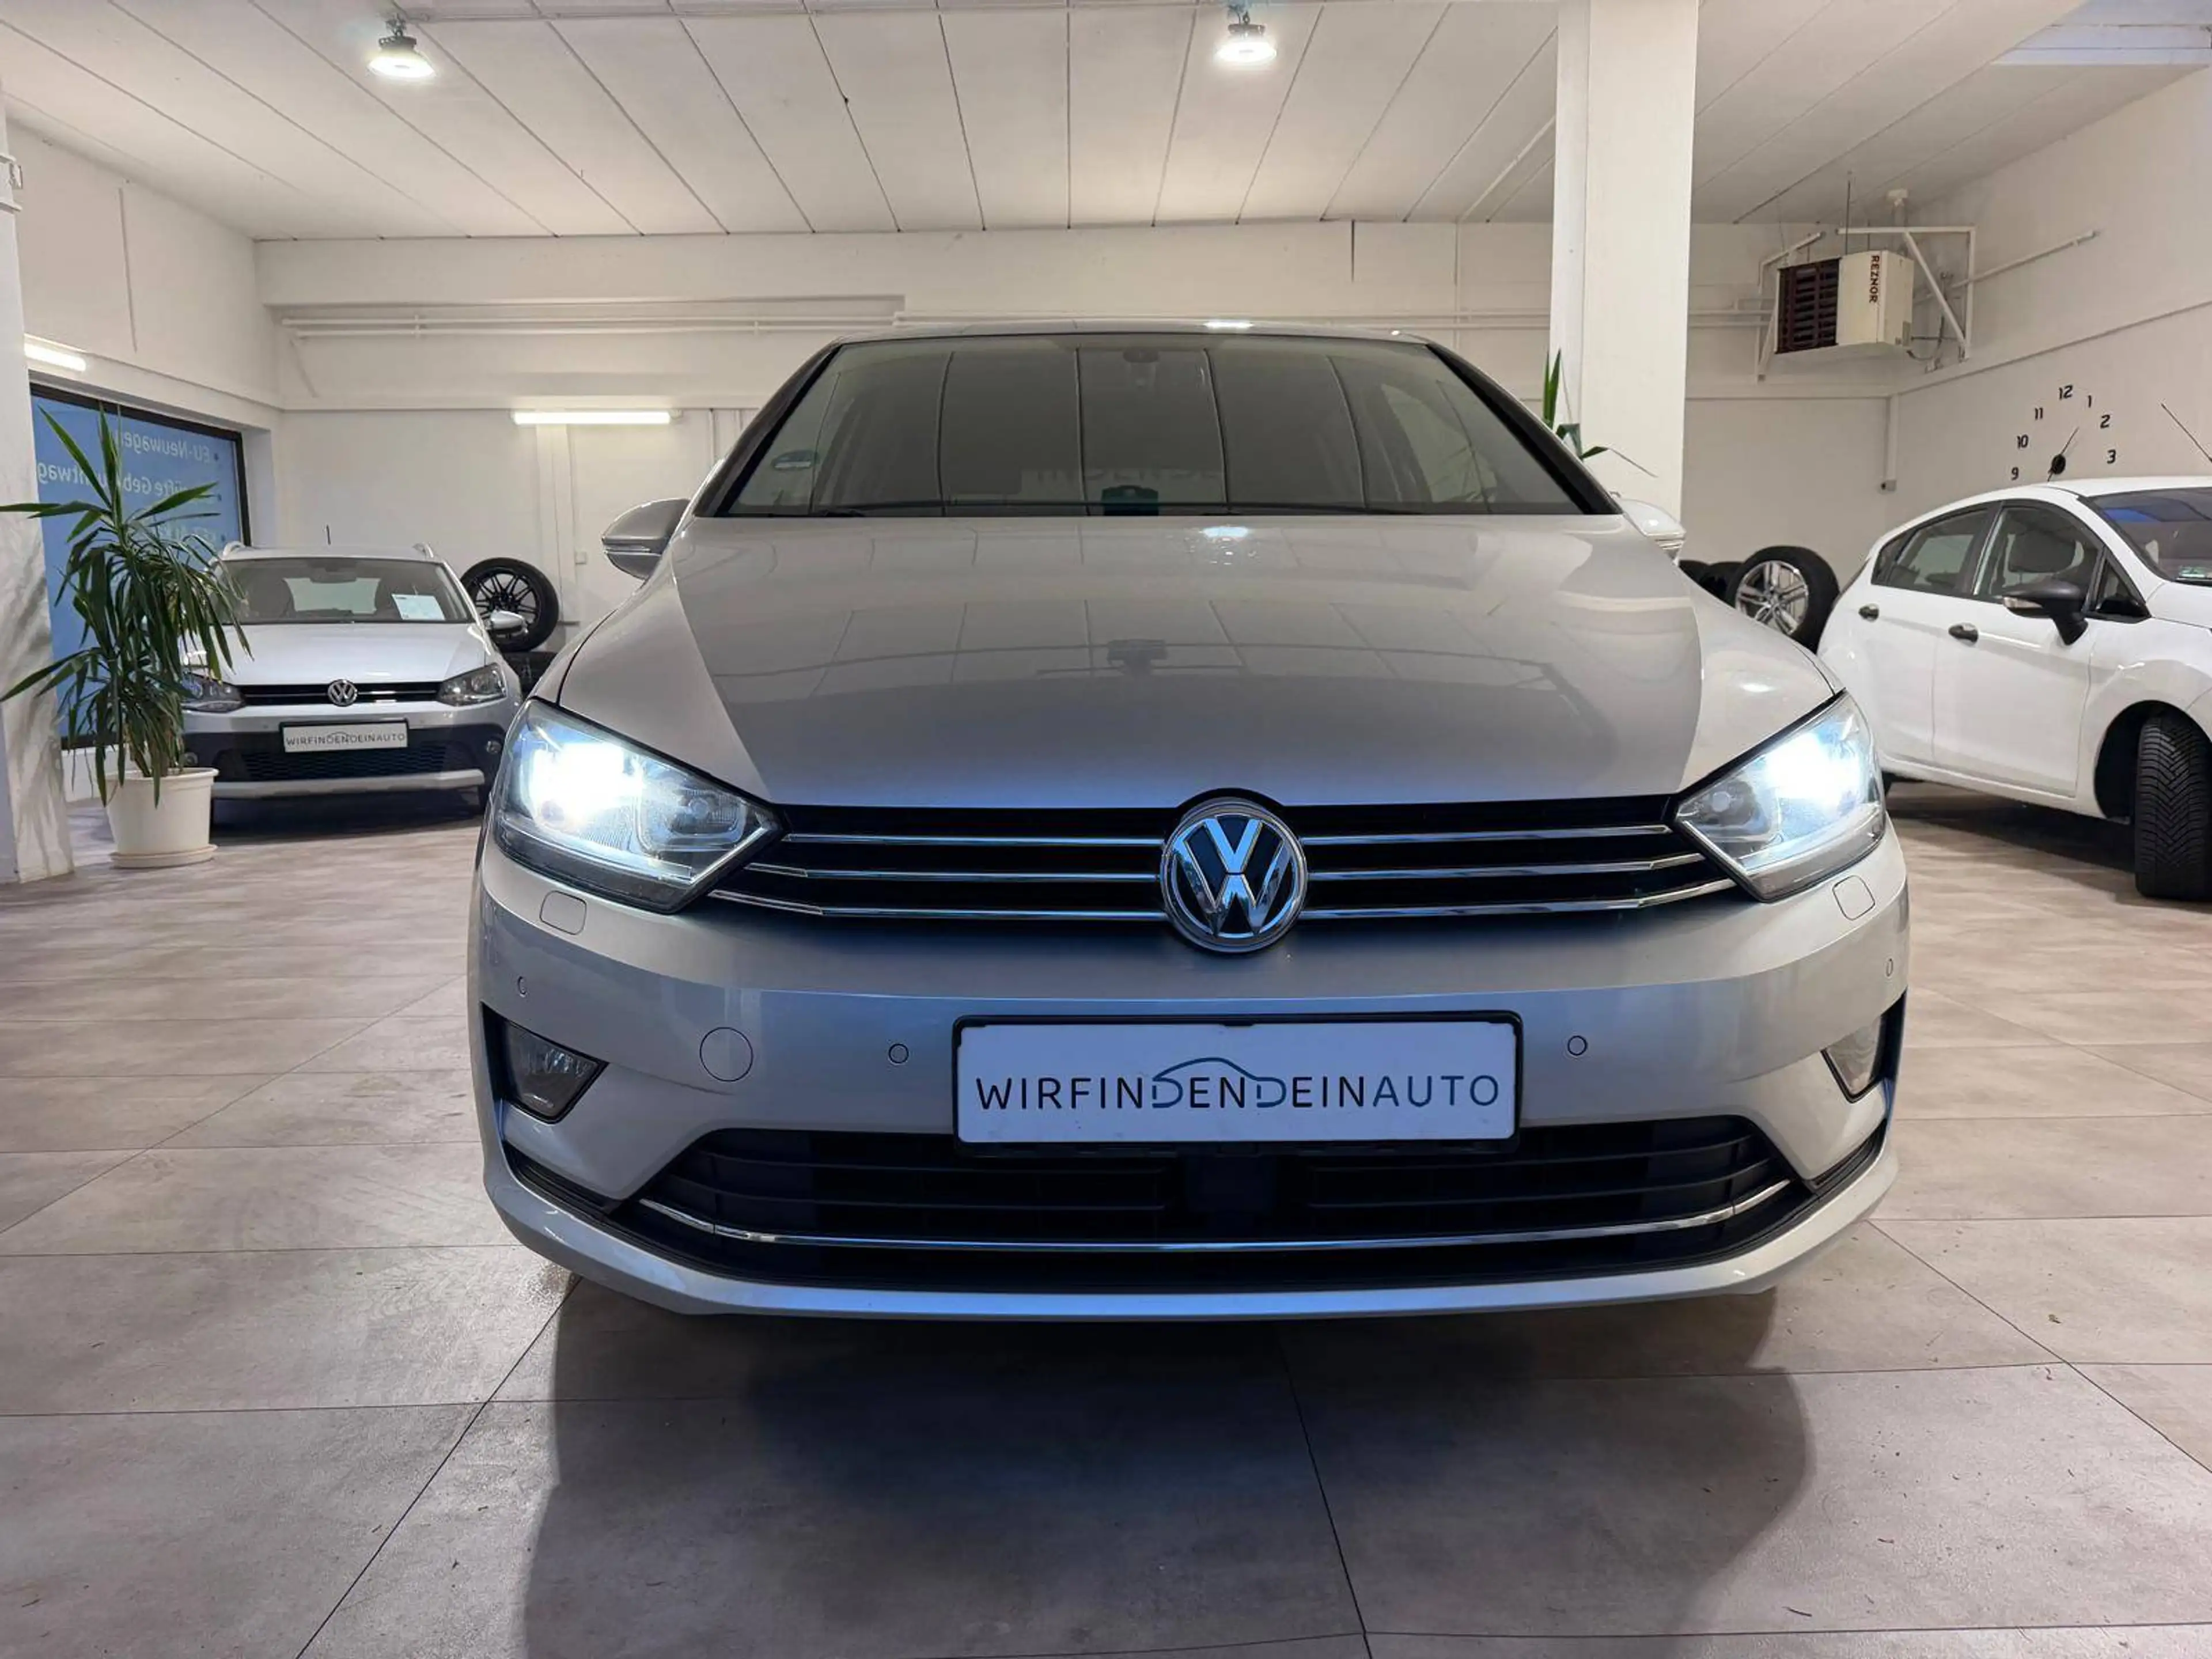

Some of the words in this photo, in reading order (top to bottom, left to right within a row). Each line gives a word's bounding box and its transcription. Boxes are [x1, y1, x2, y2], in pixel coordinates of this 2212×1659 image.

[1869, 255, 1880, 304] REZNOR
[2058, 385, 2073, 400] 12
[2087, 395, 2092, 408] 1
[2035, 407, 2043, 421] 11
[2100, 414, 2111, 429] 2
[2017, 434, 2029, 449] 10
[2107, 449, 2116, 464] 3
[2011, 467, 2020, 480] 9
[329, 681, 357, 704] VW
[1168, 811, 1298, 940] VW
[975, 1074, 1499, 1111] WIRFINDENDEINAUTO
